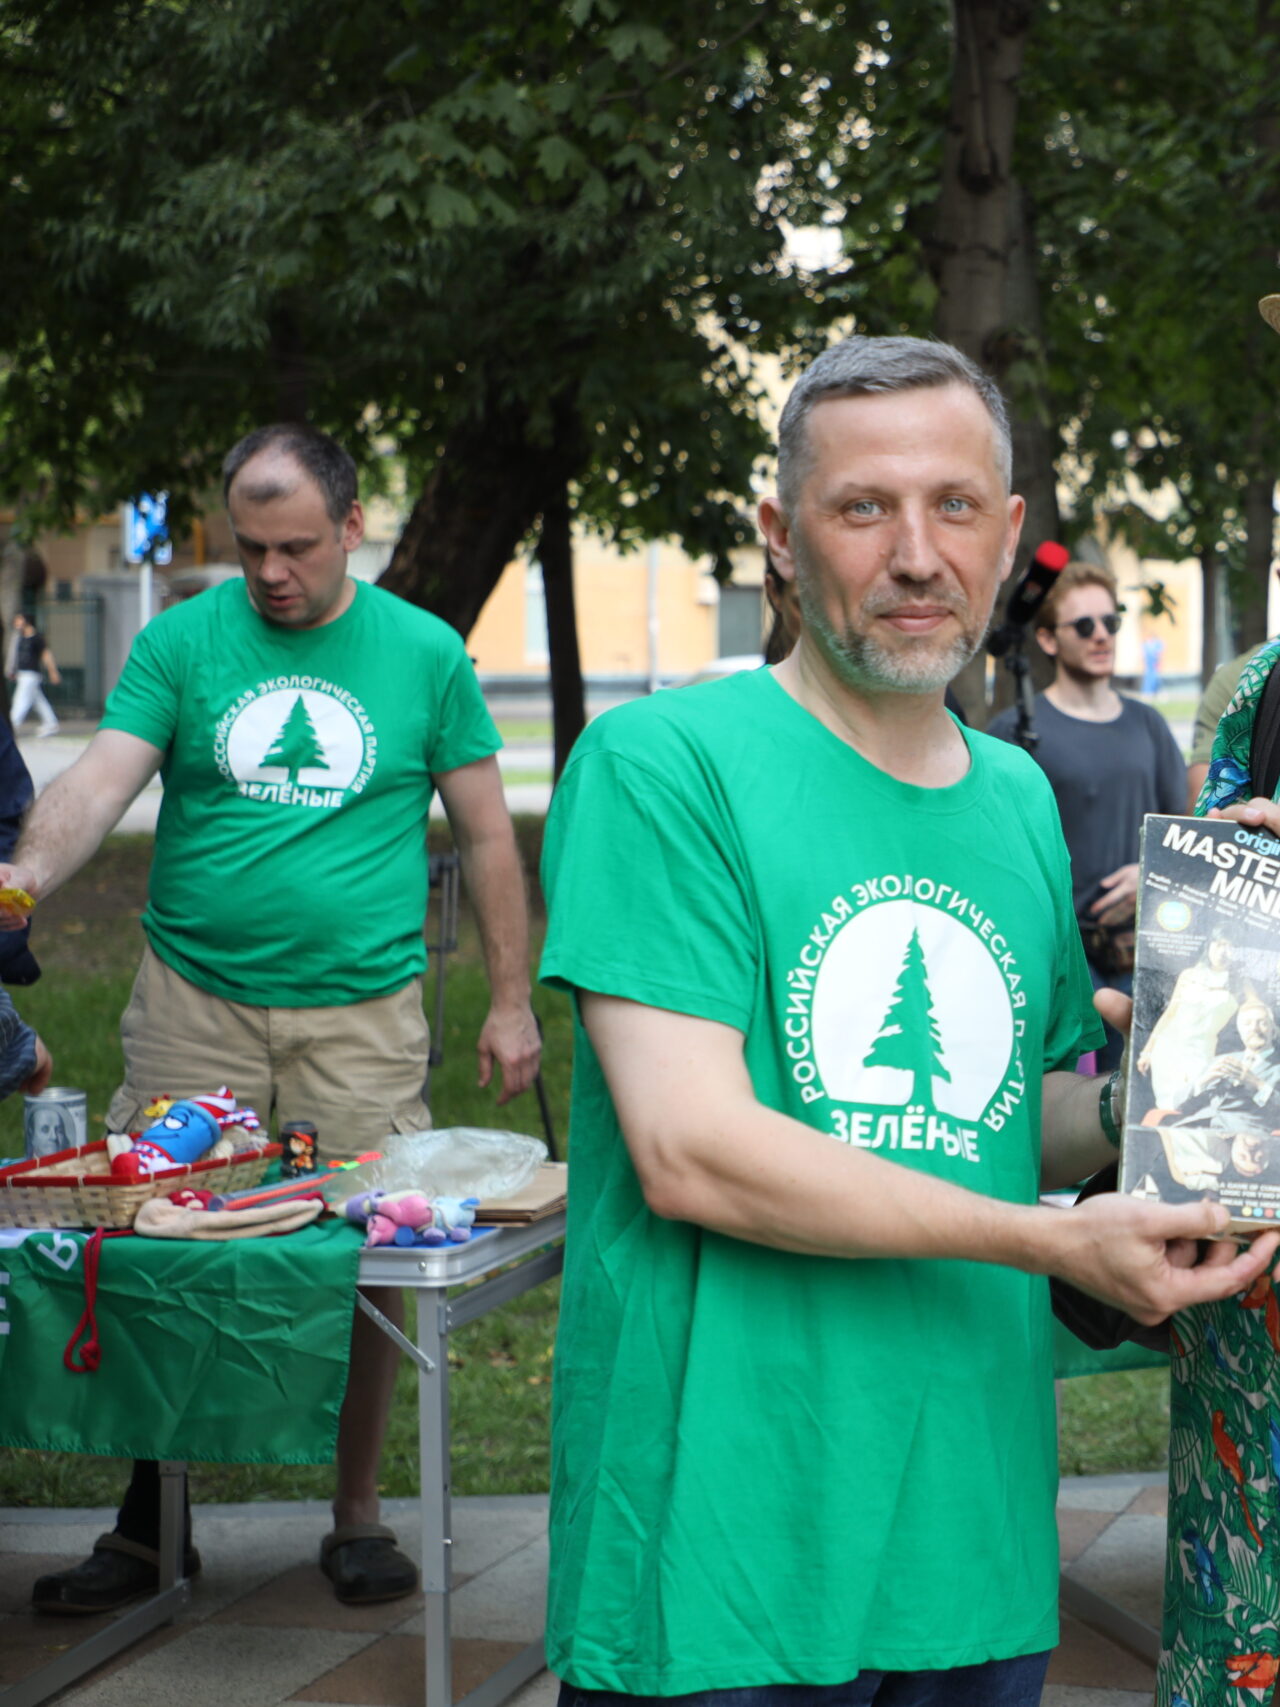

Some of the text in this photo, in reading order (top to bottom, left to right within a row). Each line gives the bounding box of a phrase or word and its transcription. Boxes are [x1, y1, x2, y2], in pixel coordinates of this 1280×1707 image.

[257, 674, 375, 735] ЭКОЛОГИЧЕСКАЯ
[351, 735, 378, 795] ПАРТИЯ
[784, 895, 854, 1104] РОССИЙСКАЯ
[851, 874, 1026, 1009] ЭКОЛОГИЧЕСКАЯ
[828, 1104, 981, 1163] ЗЕЛЁНЫЕ
